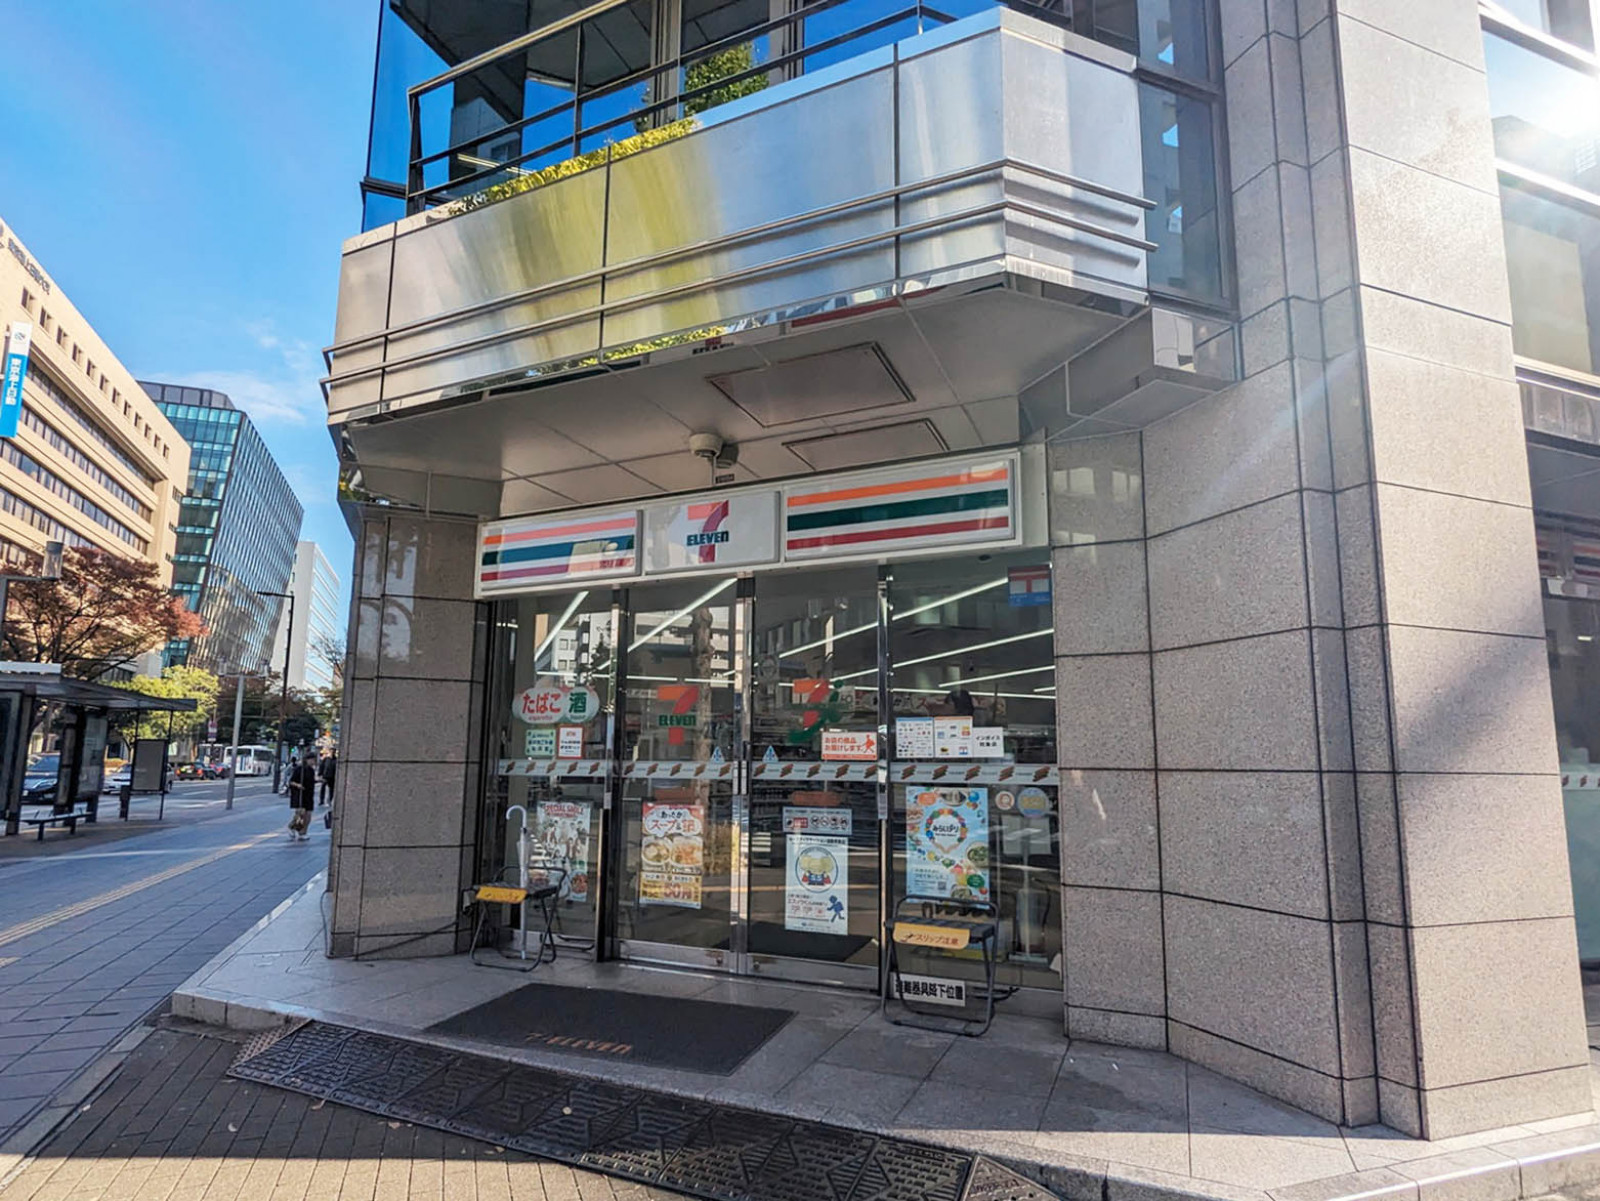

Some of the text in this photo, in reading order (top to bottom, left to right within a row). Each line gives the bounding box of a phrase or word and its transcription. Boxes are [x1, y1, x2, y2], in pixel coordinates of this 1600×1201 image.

[687, 499, 729, 563] 7
[522, 692, 562, 714] たばこ
[569, 691, 588, 714] 酒
